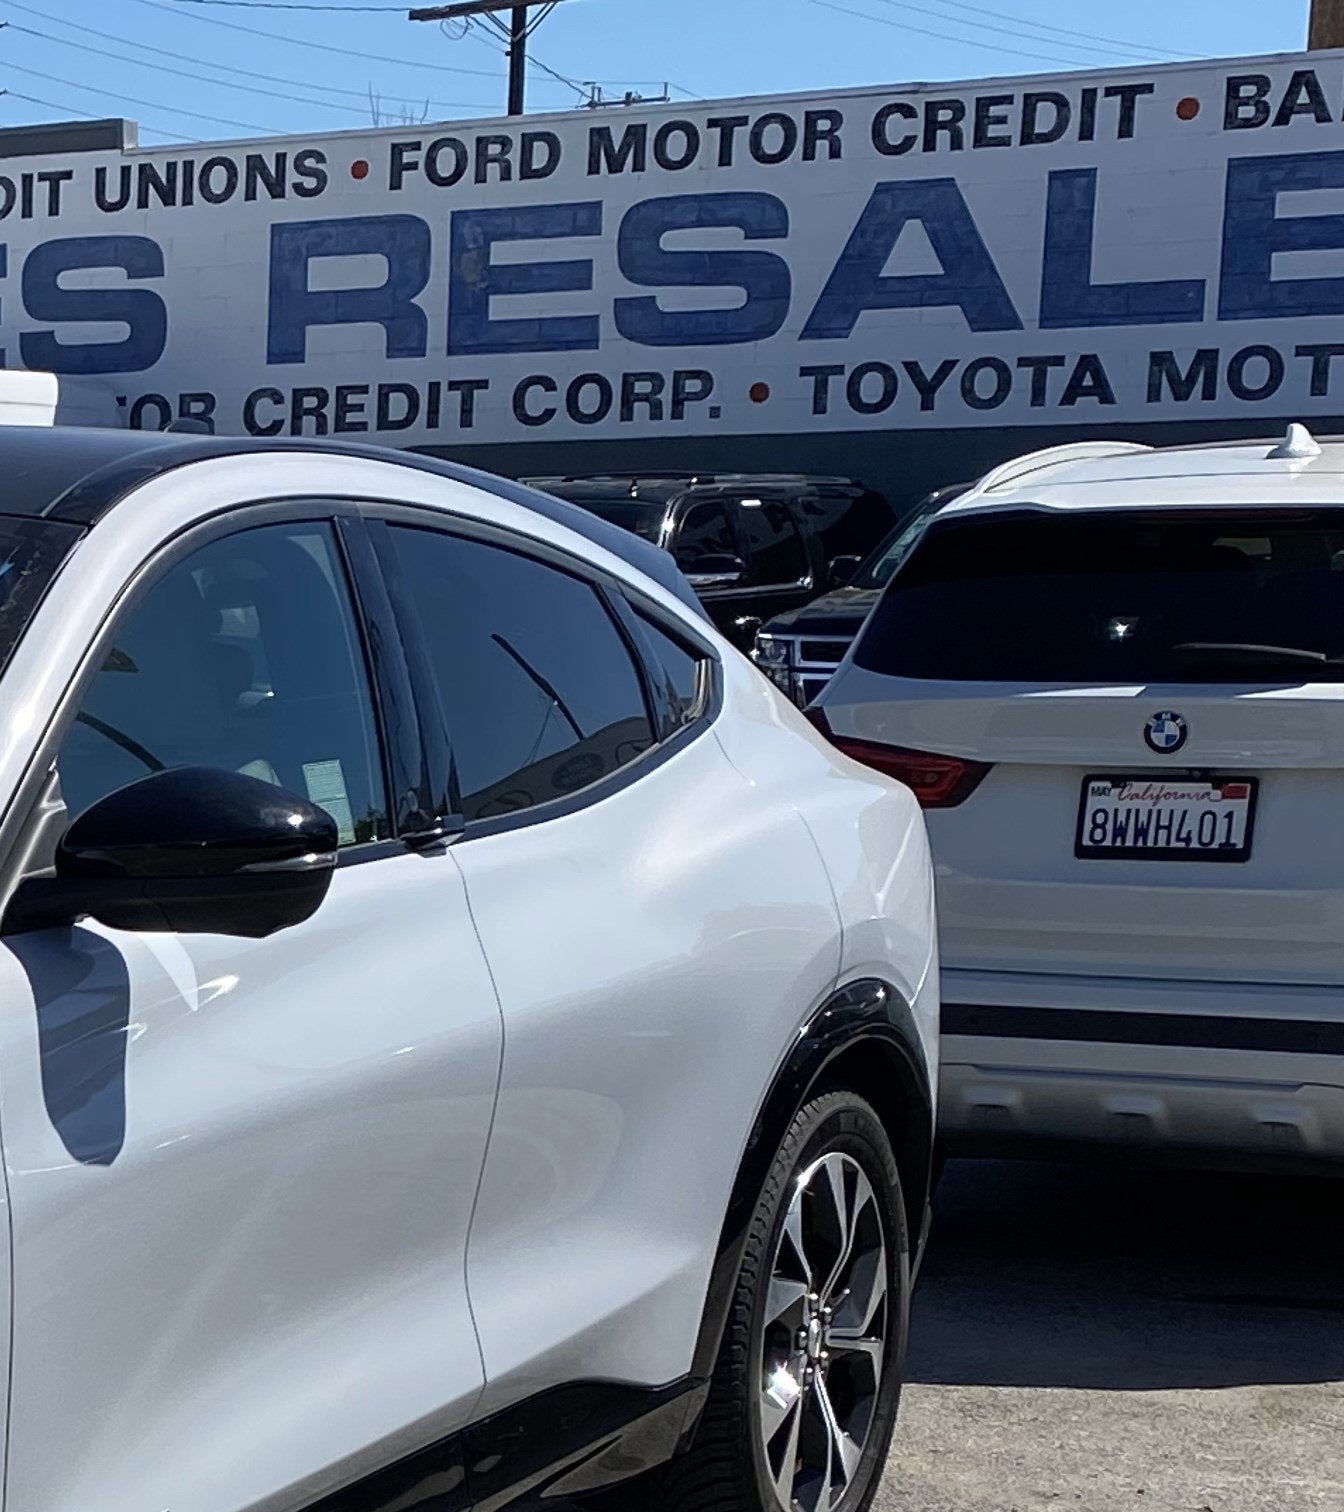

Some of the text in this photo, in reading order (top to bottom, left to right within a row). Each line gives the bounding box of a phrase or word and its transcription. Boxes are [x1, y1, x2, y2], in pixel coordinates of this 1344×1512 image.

[93, 148, 330, 214] UNIONS
[388, 129, 562, 192] FORD
[586, 109, 844, 177] MOTOR
[870, 82, 1156, 157] CREDIT
[1223, 69, 1344, 131] BA
[266, 151, 1344, 366] RESALE
[116, 344, 1344, 437] OR CREDIT CORP. TOYOTA MOT
[1088, 807, 1238, 850] 8WWH401
[1117, 781, 1214, 806] California
